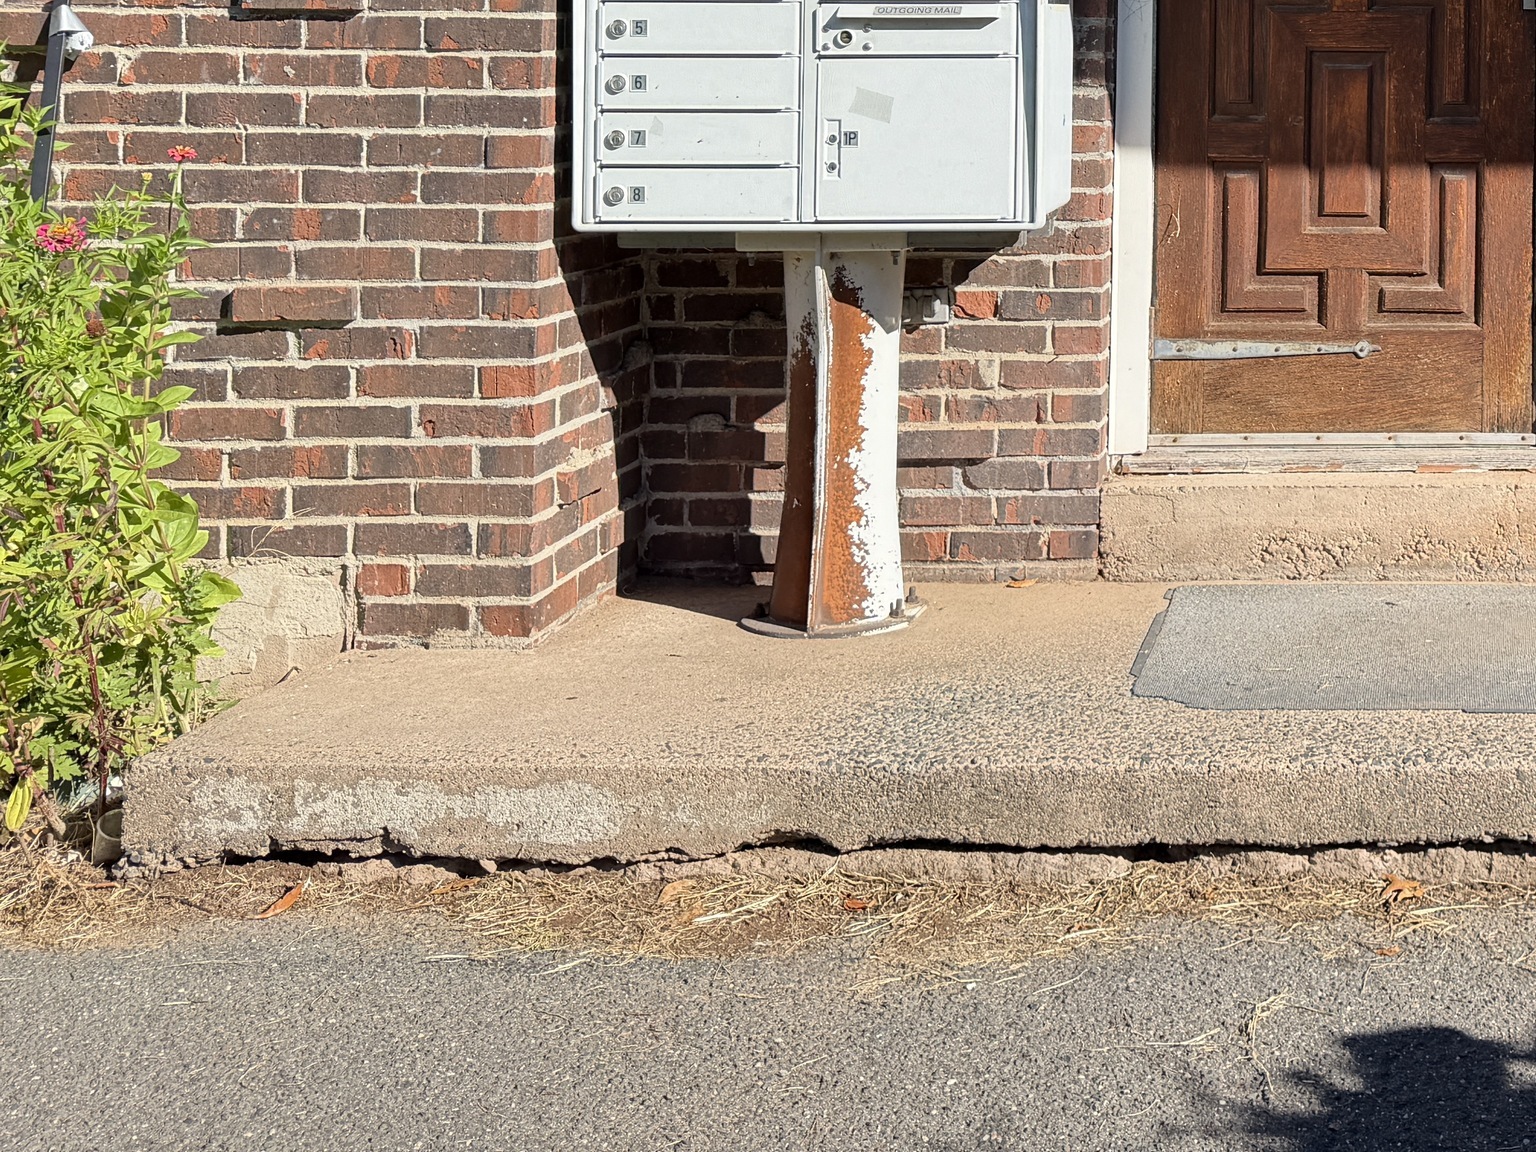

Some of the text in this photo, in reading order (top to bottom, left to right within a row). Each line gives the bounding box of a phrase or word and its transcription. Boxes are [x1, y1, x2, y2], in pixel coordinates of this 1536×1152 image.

[877, 6, 959, 15] OUTGOING MAIL
[635, 21, 643, 35] 5
[634, 75, 642, 89] 6
[634, 131, 642, 145] 7
[843, 132, 857, 145] 1P
[633, 187, 641, 201] 8
